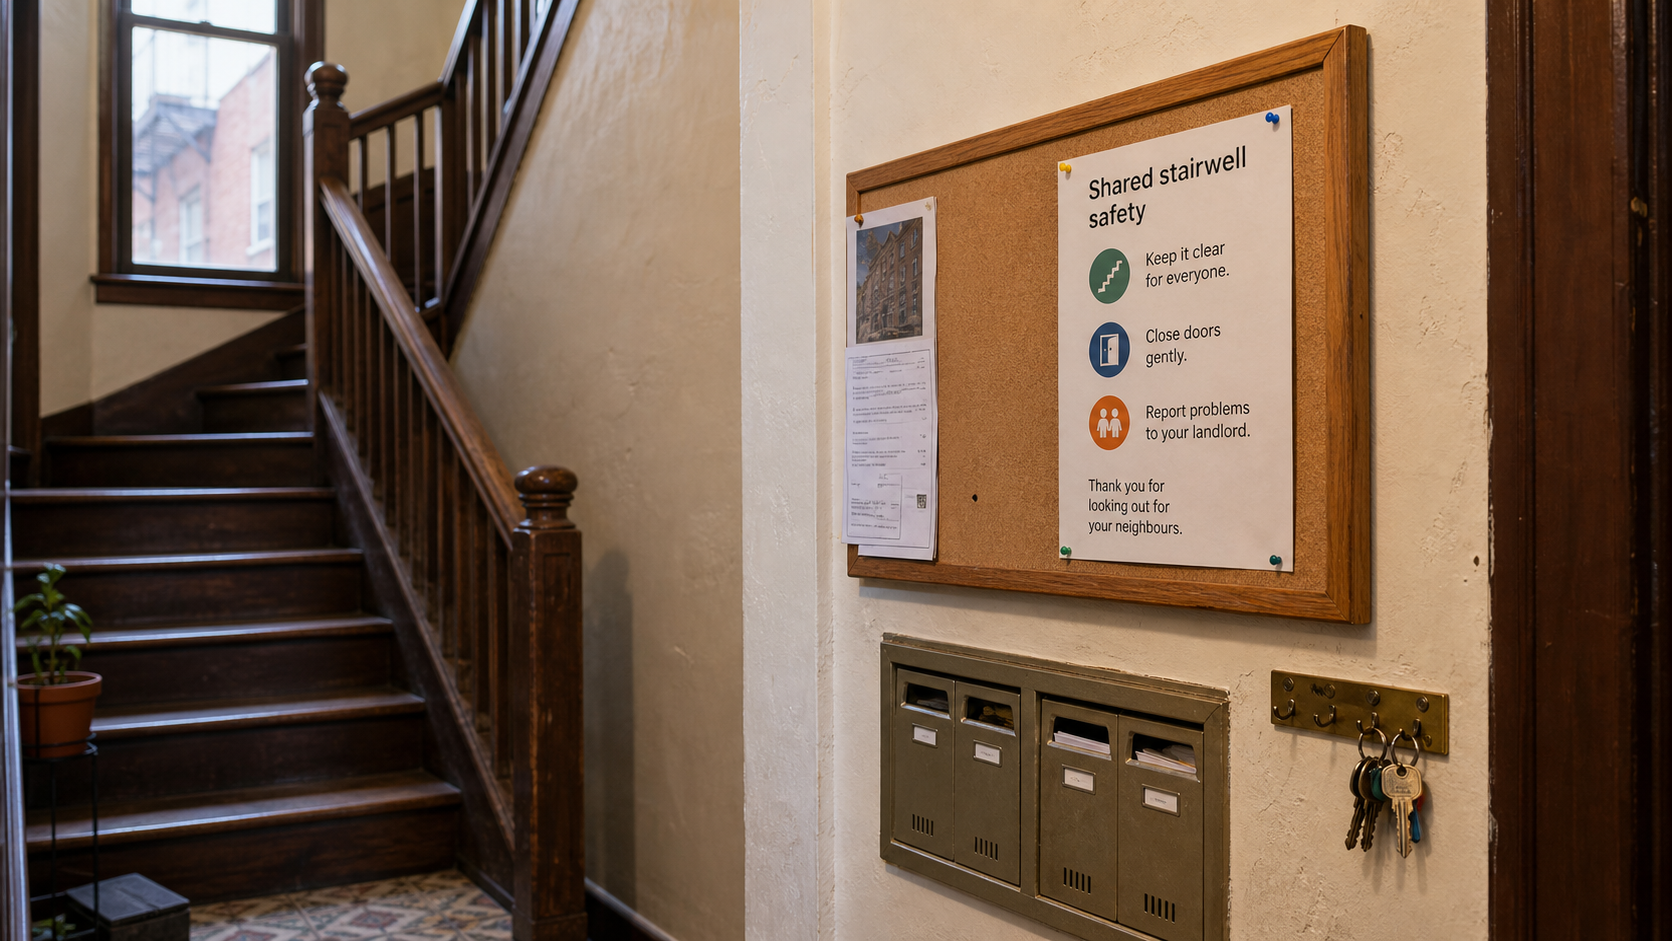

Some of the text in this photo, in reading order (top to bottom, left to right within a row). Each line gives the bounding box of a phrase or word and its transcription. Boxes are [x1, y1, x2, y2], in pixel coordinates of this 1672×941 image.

[1089, 145, 1245, 199] Shared stairwell
[1089, 203, 1146, 228] safety
[1146, 244, 1225, 266] Keep it clear
[1146, 266, 1229, 287] for everyone.
[1146, 325, 1220, 343] Close doors
[1146, 348, 1187, 368] gently.
[1147, 402, 1249, 421] Report problems
[1146, 423, 1250, 443] to your landlord.
[1088, 479, 1165, 495] Thank you for
[1089, 499, 1170, 515] looking out for
[1089, 520, 1182, 536] your neighbours.
